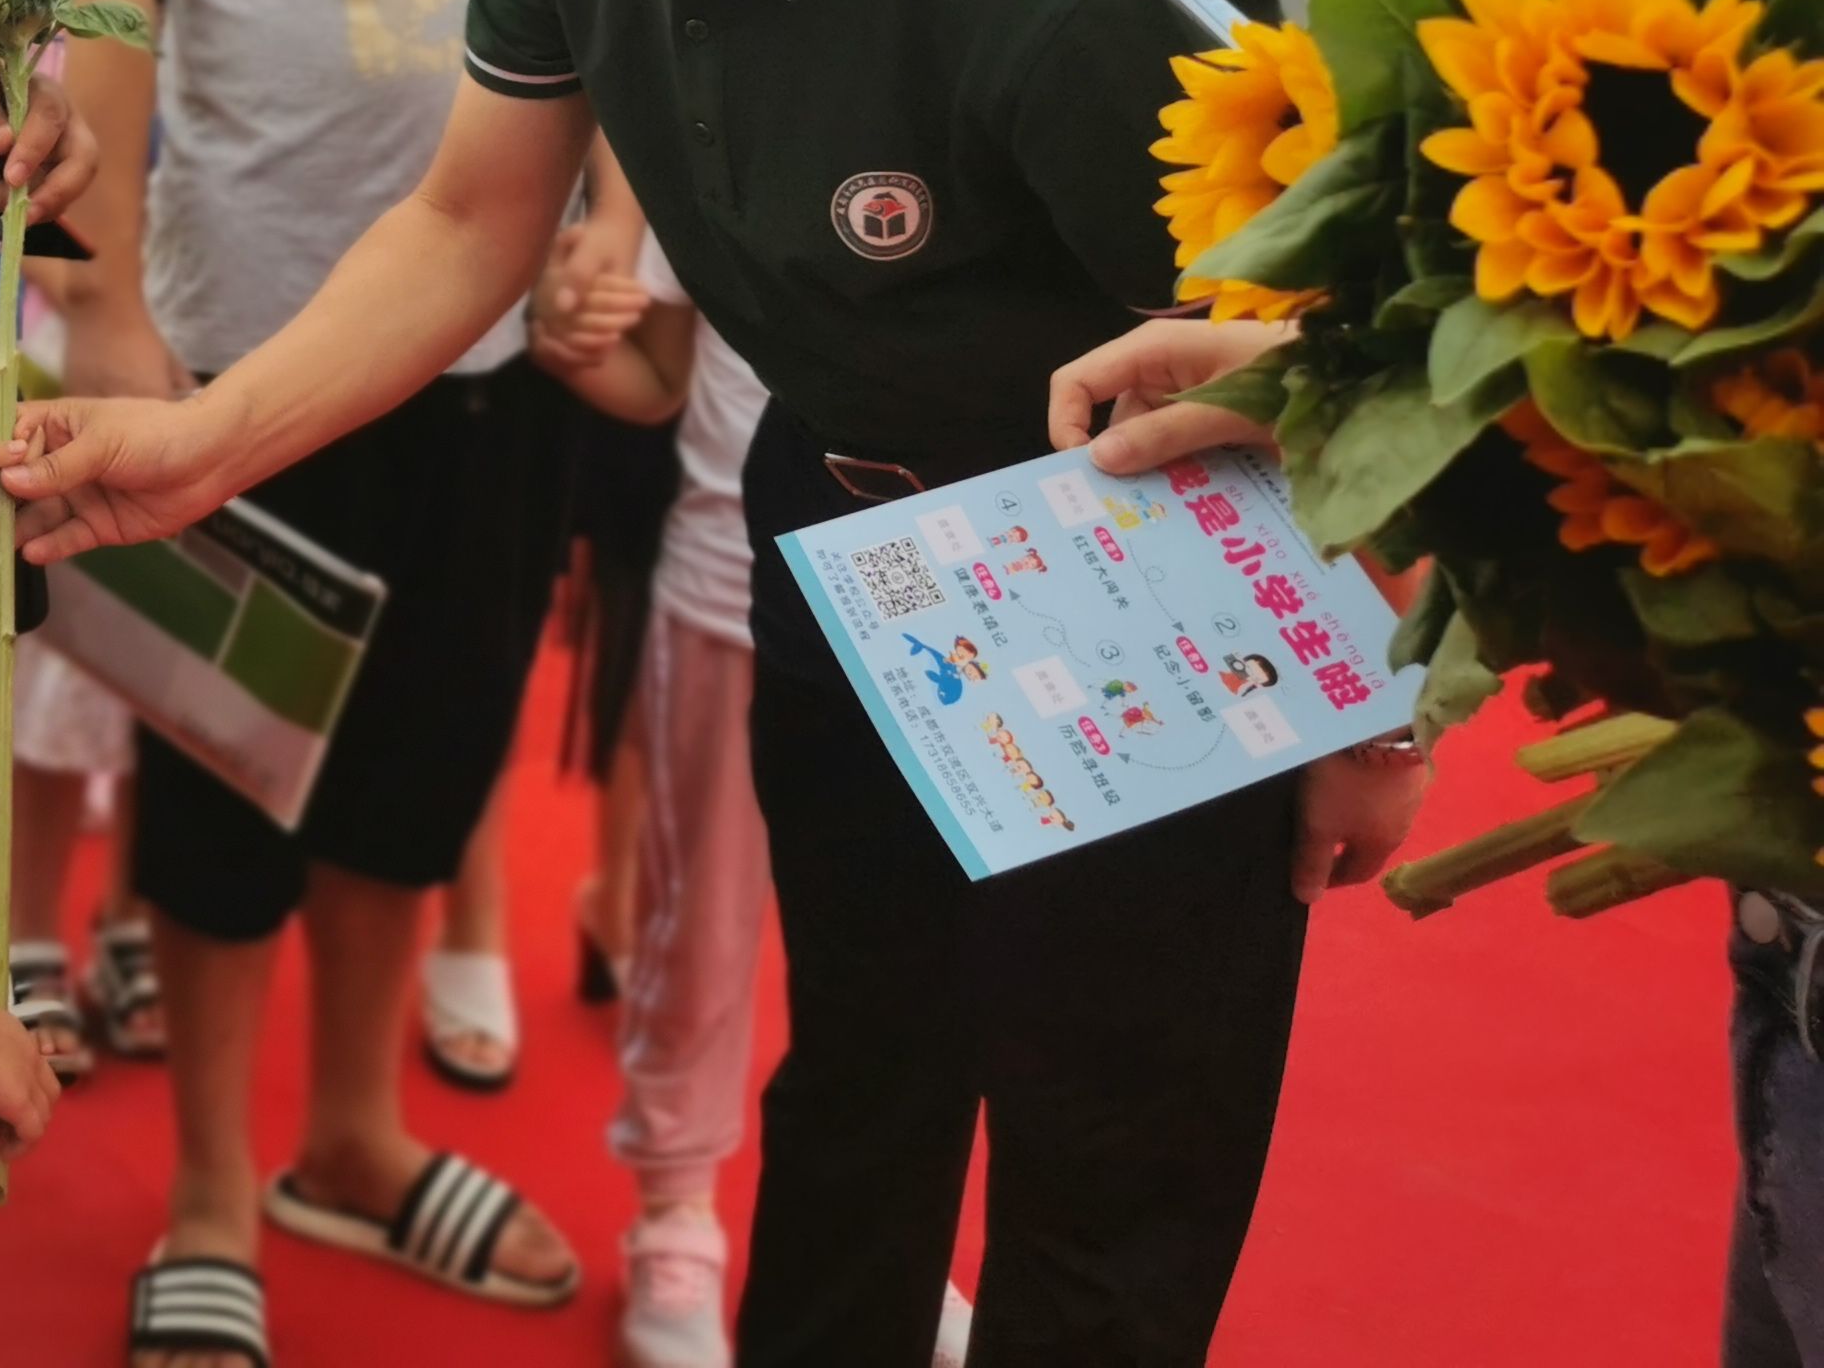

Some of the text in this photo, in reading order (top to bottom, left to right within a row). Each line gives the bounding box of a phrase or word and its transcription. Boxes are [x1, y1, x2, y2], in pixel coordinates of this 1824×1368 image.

[1163, 463, 1371, 711] 我是小学生啦
